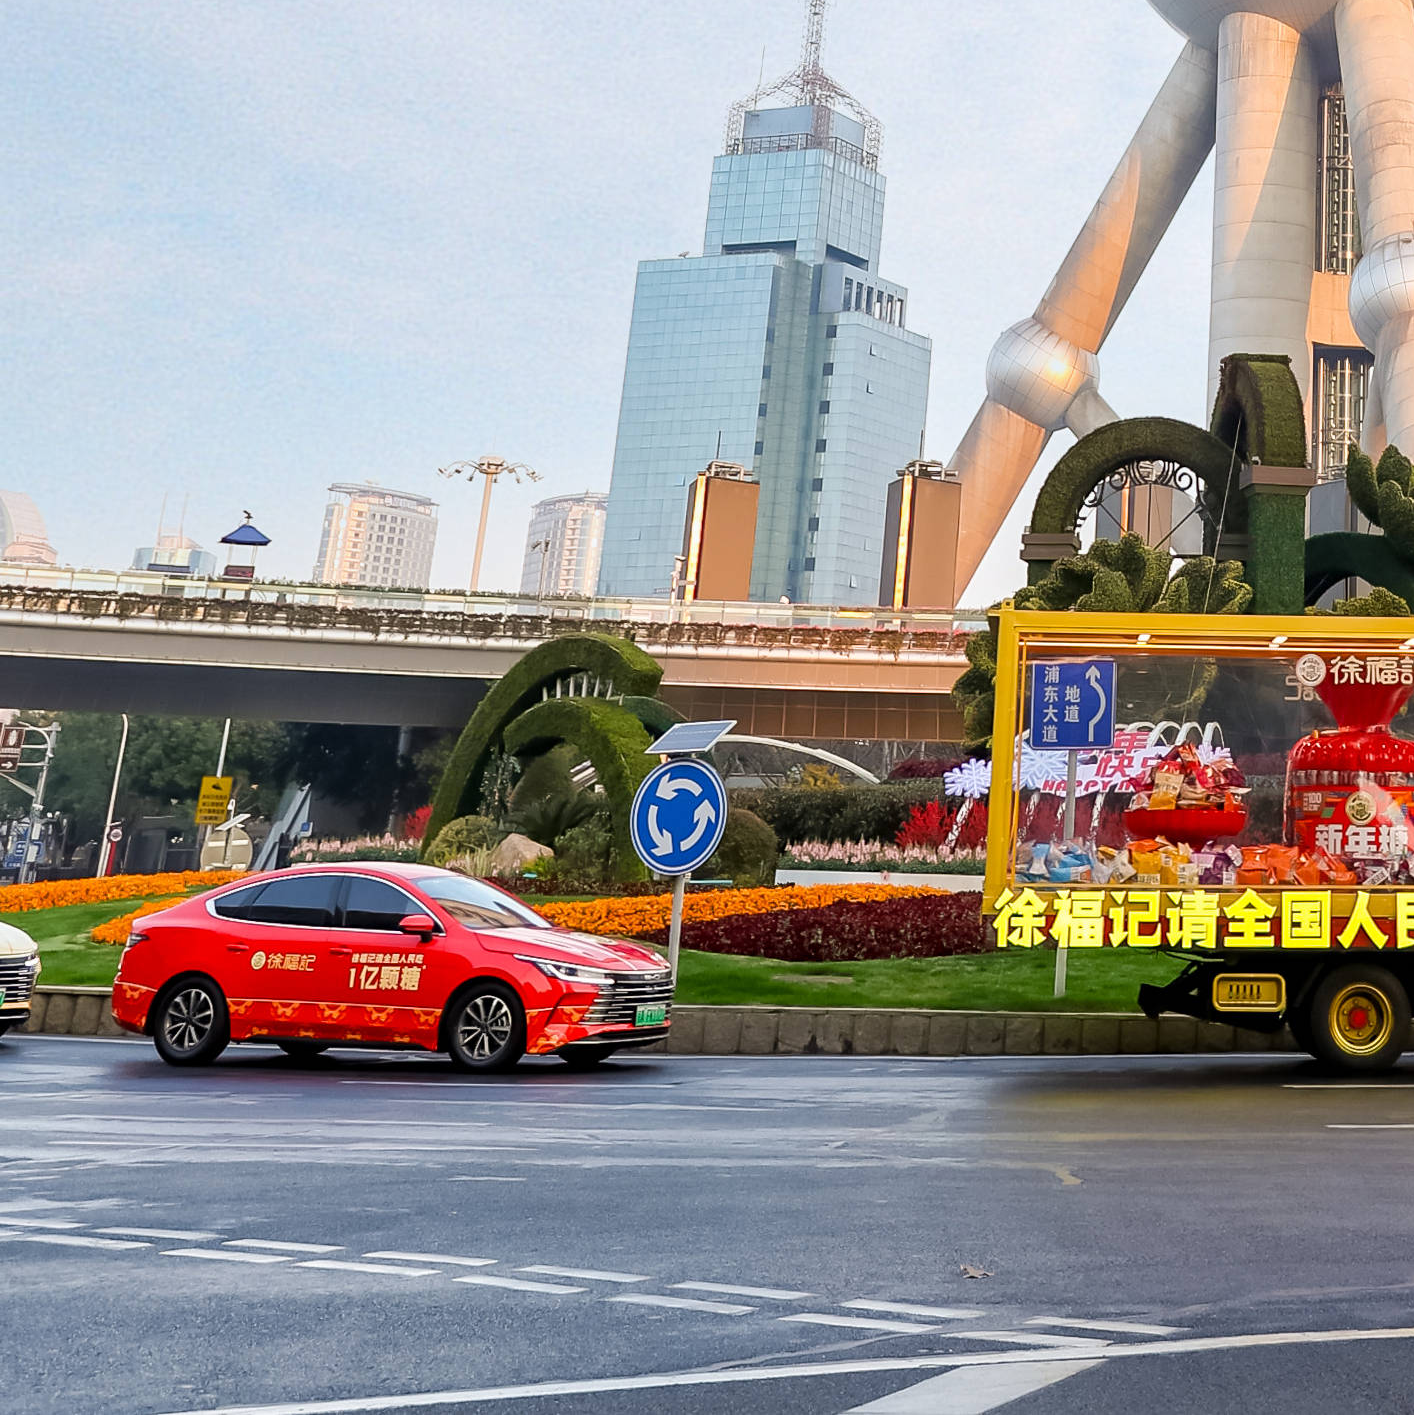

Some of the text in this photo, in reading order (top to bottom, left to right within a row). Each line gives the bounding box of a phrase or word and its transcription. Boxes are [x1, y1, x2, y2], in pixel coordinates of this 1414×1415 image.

[1042, 666, 1060, 743] 浦东大道
[1064, 685, 1080, 722] 地道
[1094, 755, 1161, 777] 快
[1315, 824, 1408, 855] 新年糖
[267, 953, 316, 971] 徐福記
